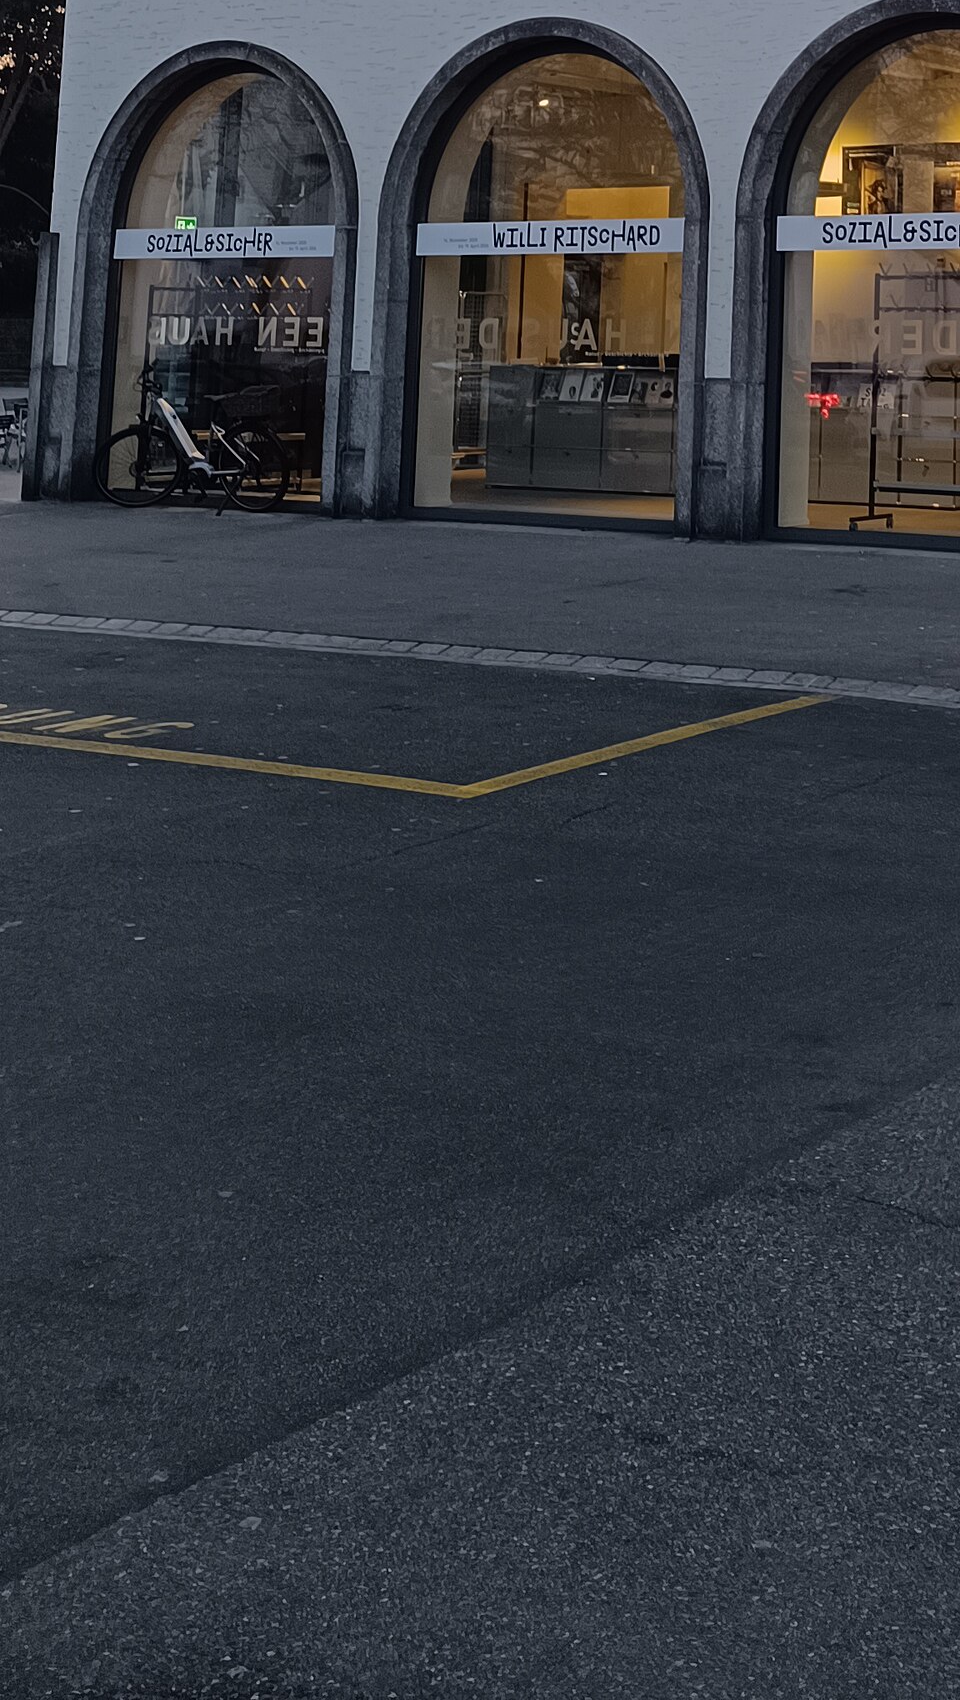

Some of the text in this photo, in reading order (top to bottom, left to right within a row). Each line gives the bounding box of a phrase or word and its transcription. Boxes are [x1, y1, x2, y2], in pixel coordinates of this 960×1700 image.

[493, 220, 661, 252] WILLI RITSCHARD
[0, 703, 195, 739] UNG
